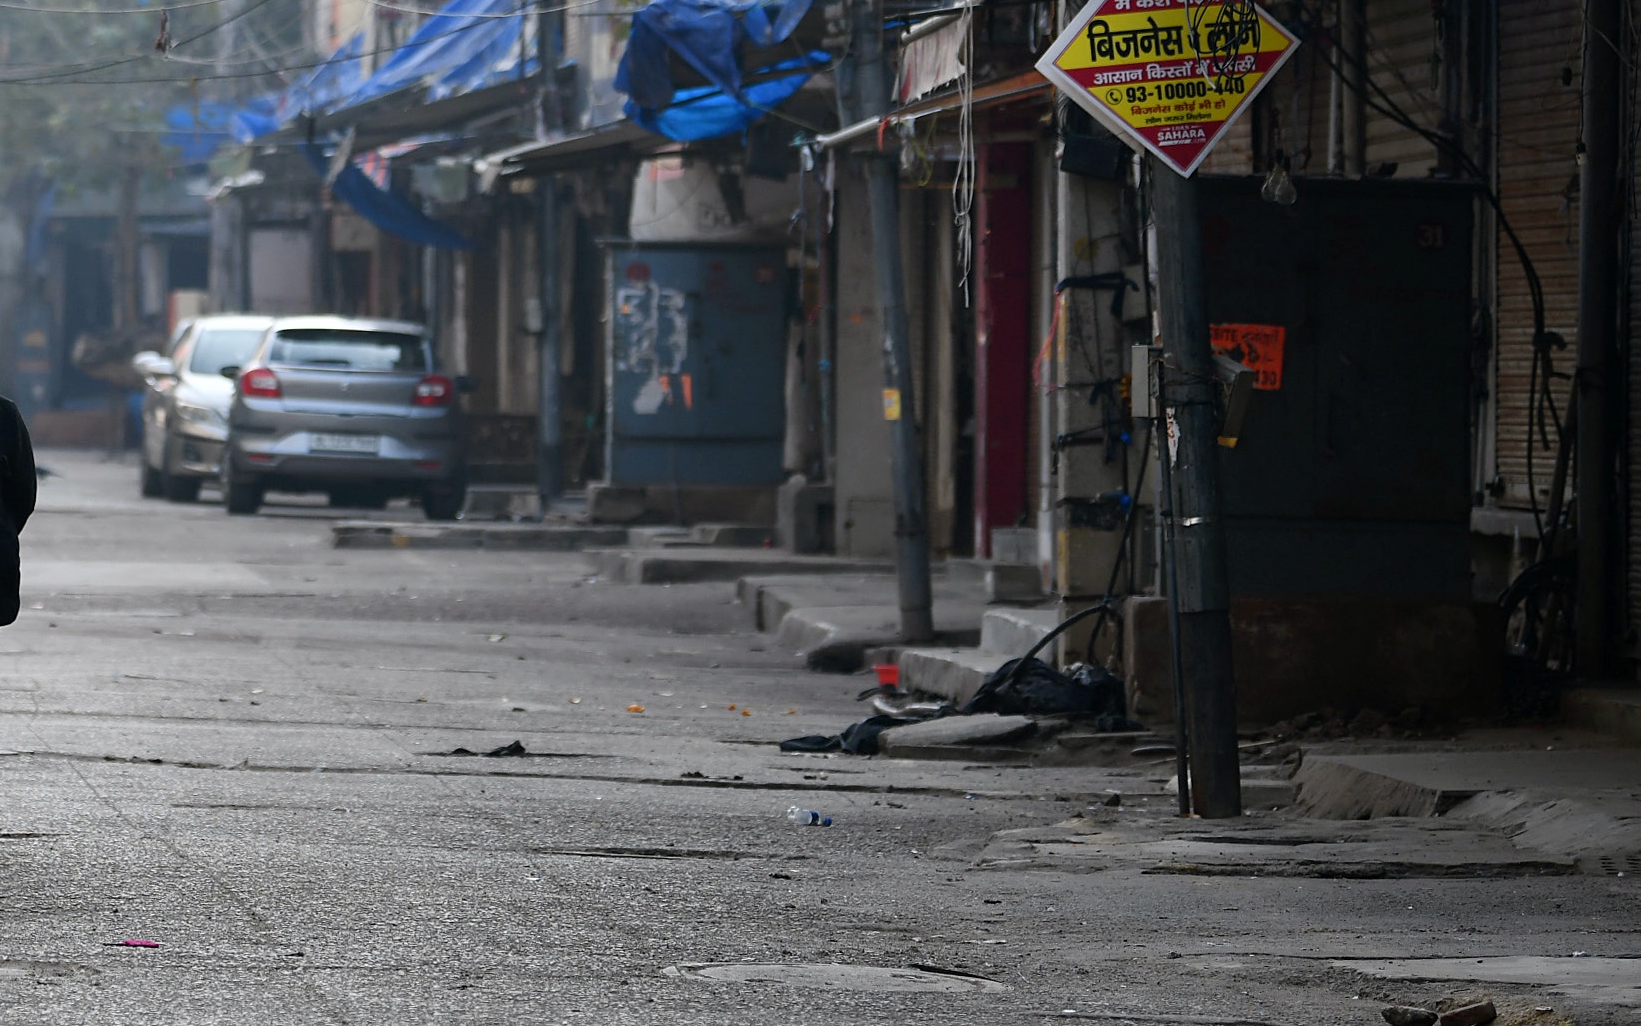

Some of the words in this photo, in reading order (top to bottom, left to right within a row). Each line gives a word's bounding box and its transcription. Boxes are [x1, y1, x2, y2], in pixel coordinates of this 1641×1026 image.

[1087, 17, 1183, 63] बिजनेस
[1093, 68, 1143, 85] आसान
[1146, 62, 1192, 81] किस्तों
[1126, 78, 1245, 104] 93-10000-440
[1130, 104, 1171, 116] बिजनेस
[1174, 100, 1196, 112] कोई
[1157, 129, 1206, 141] SAHARA
